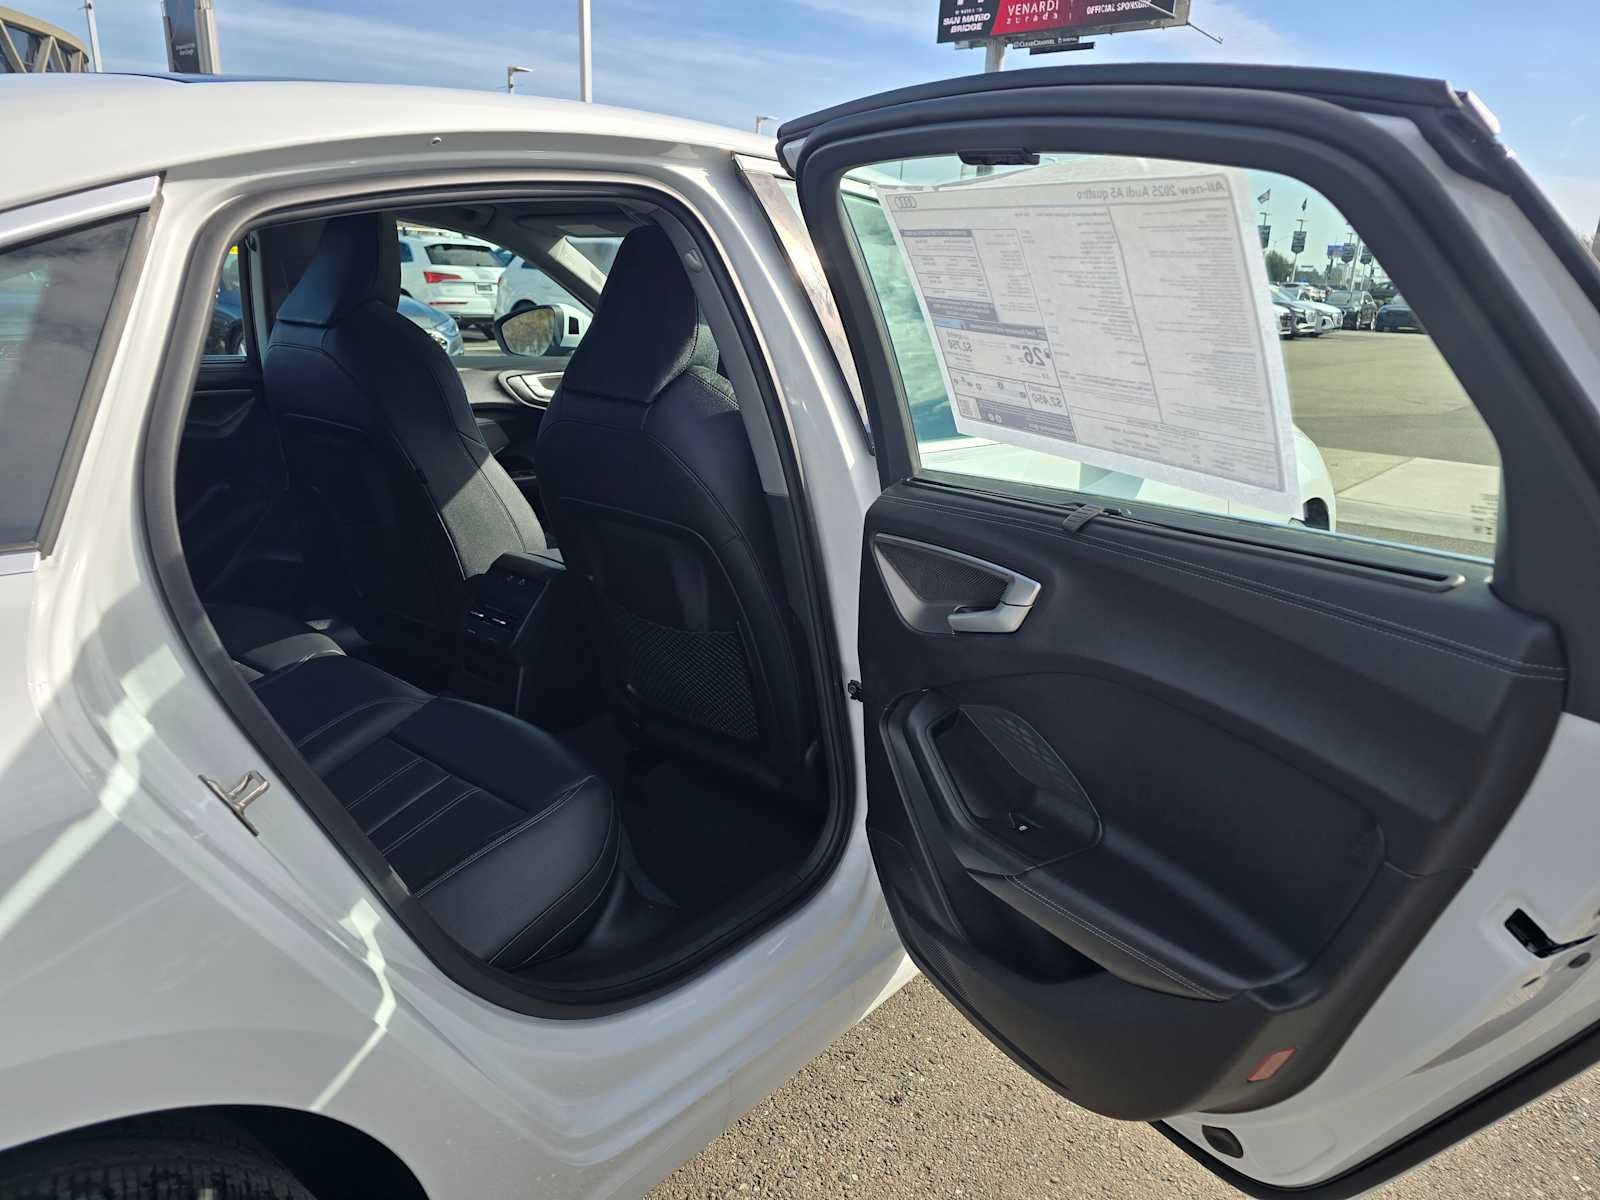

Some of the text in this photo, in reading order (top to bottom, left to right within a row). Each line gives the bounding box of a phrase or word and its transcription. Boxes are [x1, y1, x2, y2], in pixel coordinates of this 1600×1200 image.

[1007, 0, 1059, 16] VENARDI
[1086, 4, 1115, 15] OFFICIAL
[943, 13, 991, 25] SAN MATEO
[950, 22, 984, 33] BRIDGE
